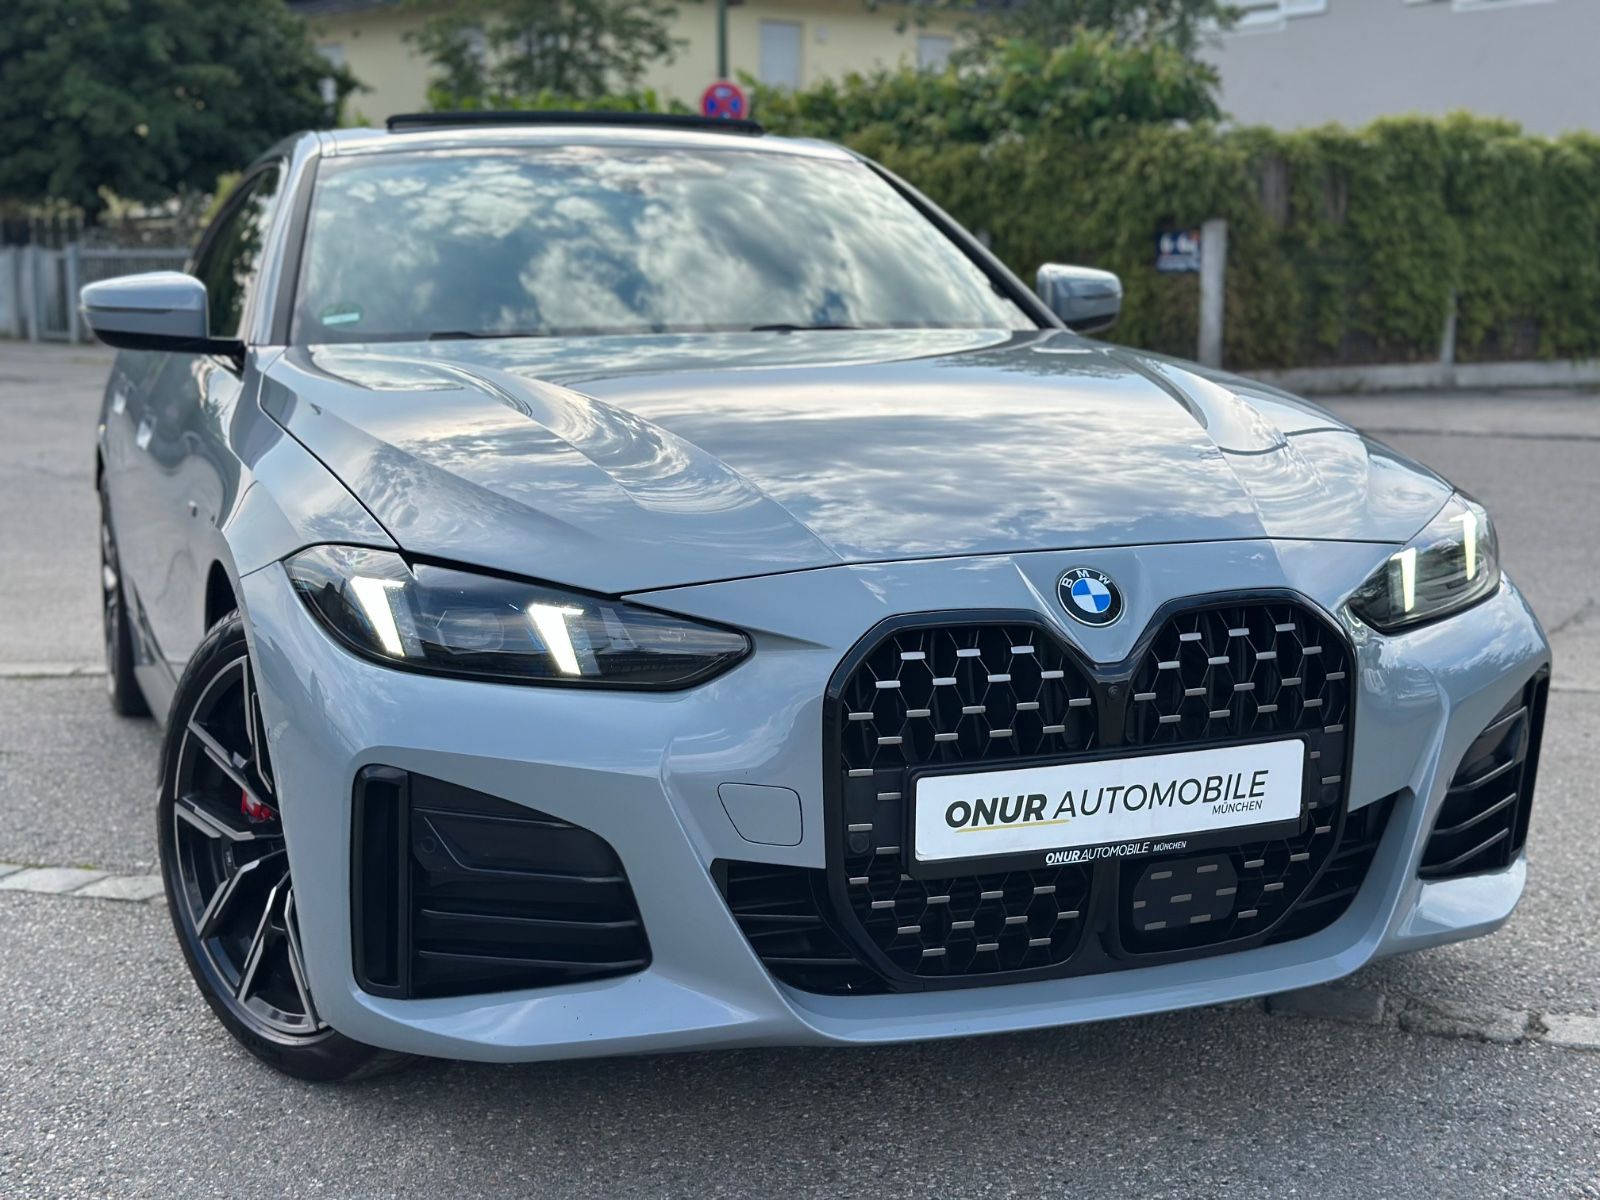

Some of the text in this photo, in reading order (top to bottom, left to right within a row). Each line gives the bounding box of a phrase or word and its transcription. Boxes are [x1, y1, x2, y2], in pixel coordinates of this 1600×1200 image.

[1061, 570, 1110, 588] BMW
[945, 769, 1269, 828] ONUR AUTOMOBILE
[1212, 800, 1263, 815] MÜNCHEN
[1153, 841, 1187, 852] MÜNCHEN
